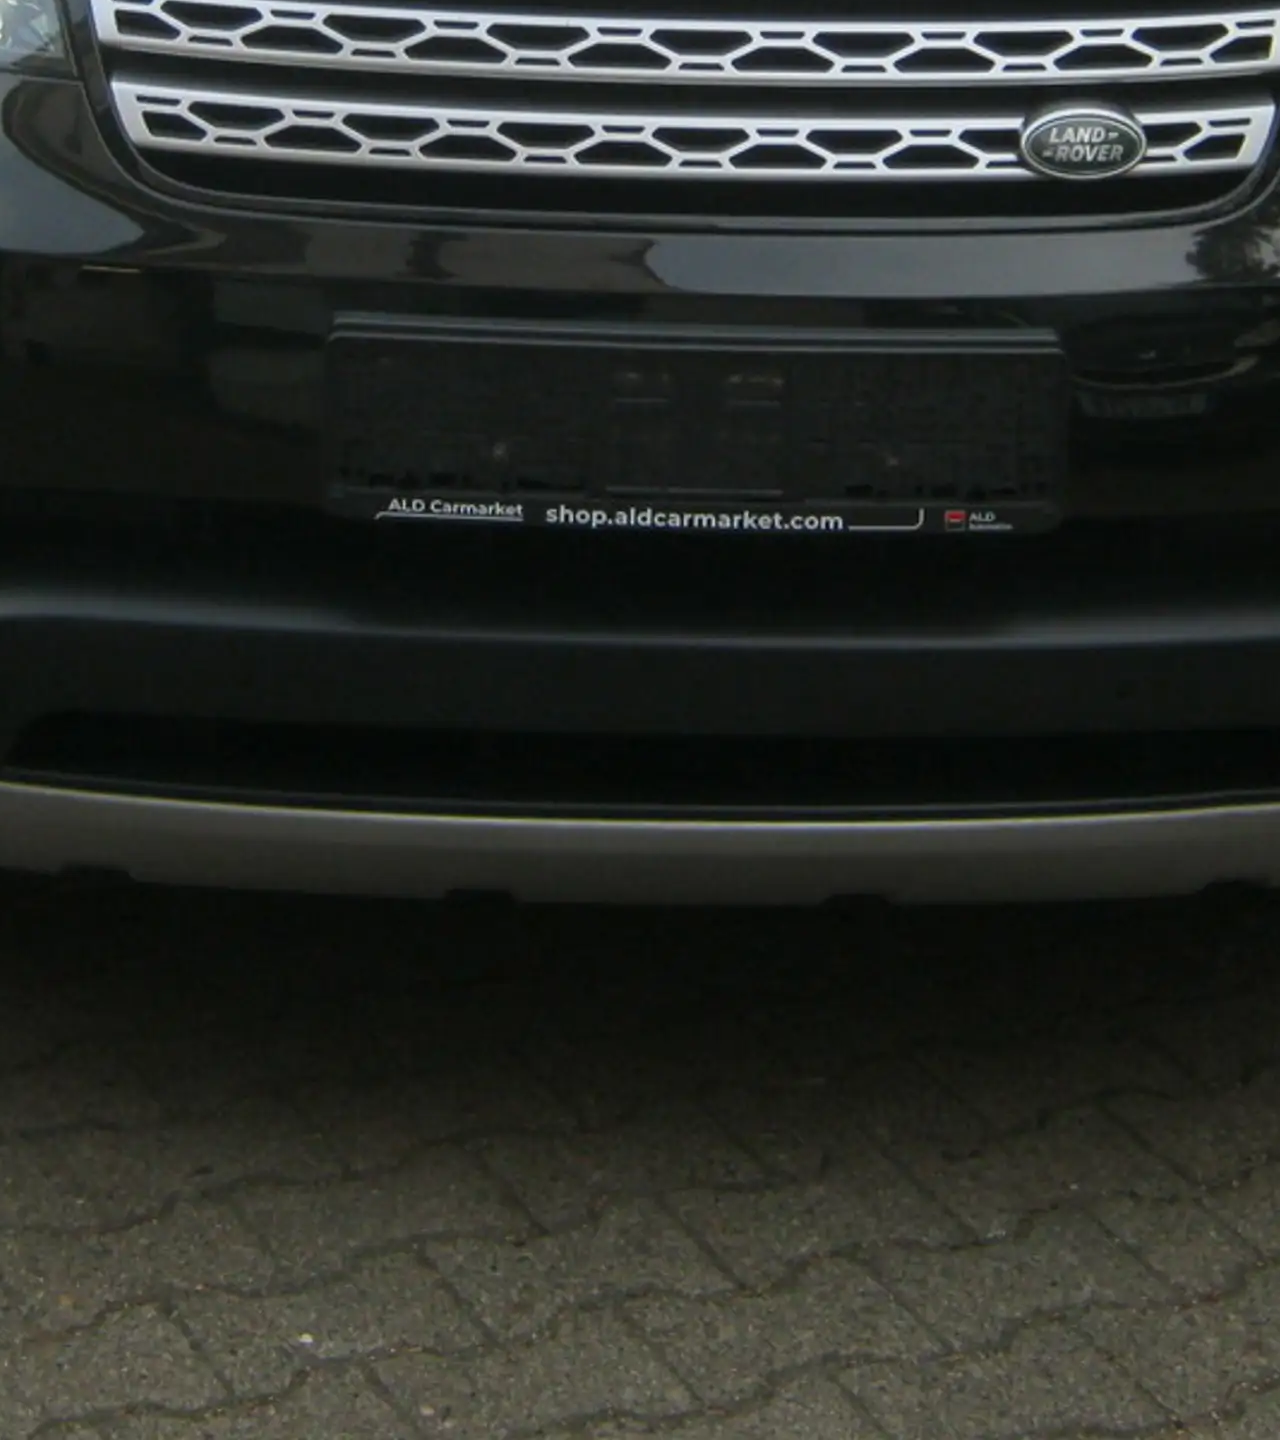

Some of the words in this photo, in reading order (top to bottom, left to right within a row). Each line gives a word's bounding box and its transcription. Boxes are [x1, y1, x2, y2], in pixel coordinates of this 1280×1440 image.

[1049, 126, 1106, 143] LAND
[1055, 144, 1124, 162] ROVER
[388, 498, 425, 512] ALD
[430, 499, 523, 516] Carmarket
[545, 504, 844, 531] shop.aldcarmarket.com
[969, 511, 996, 522] ALD
